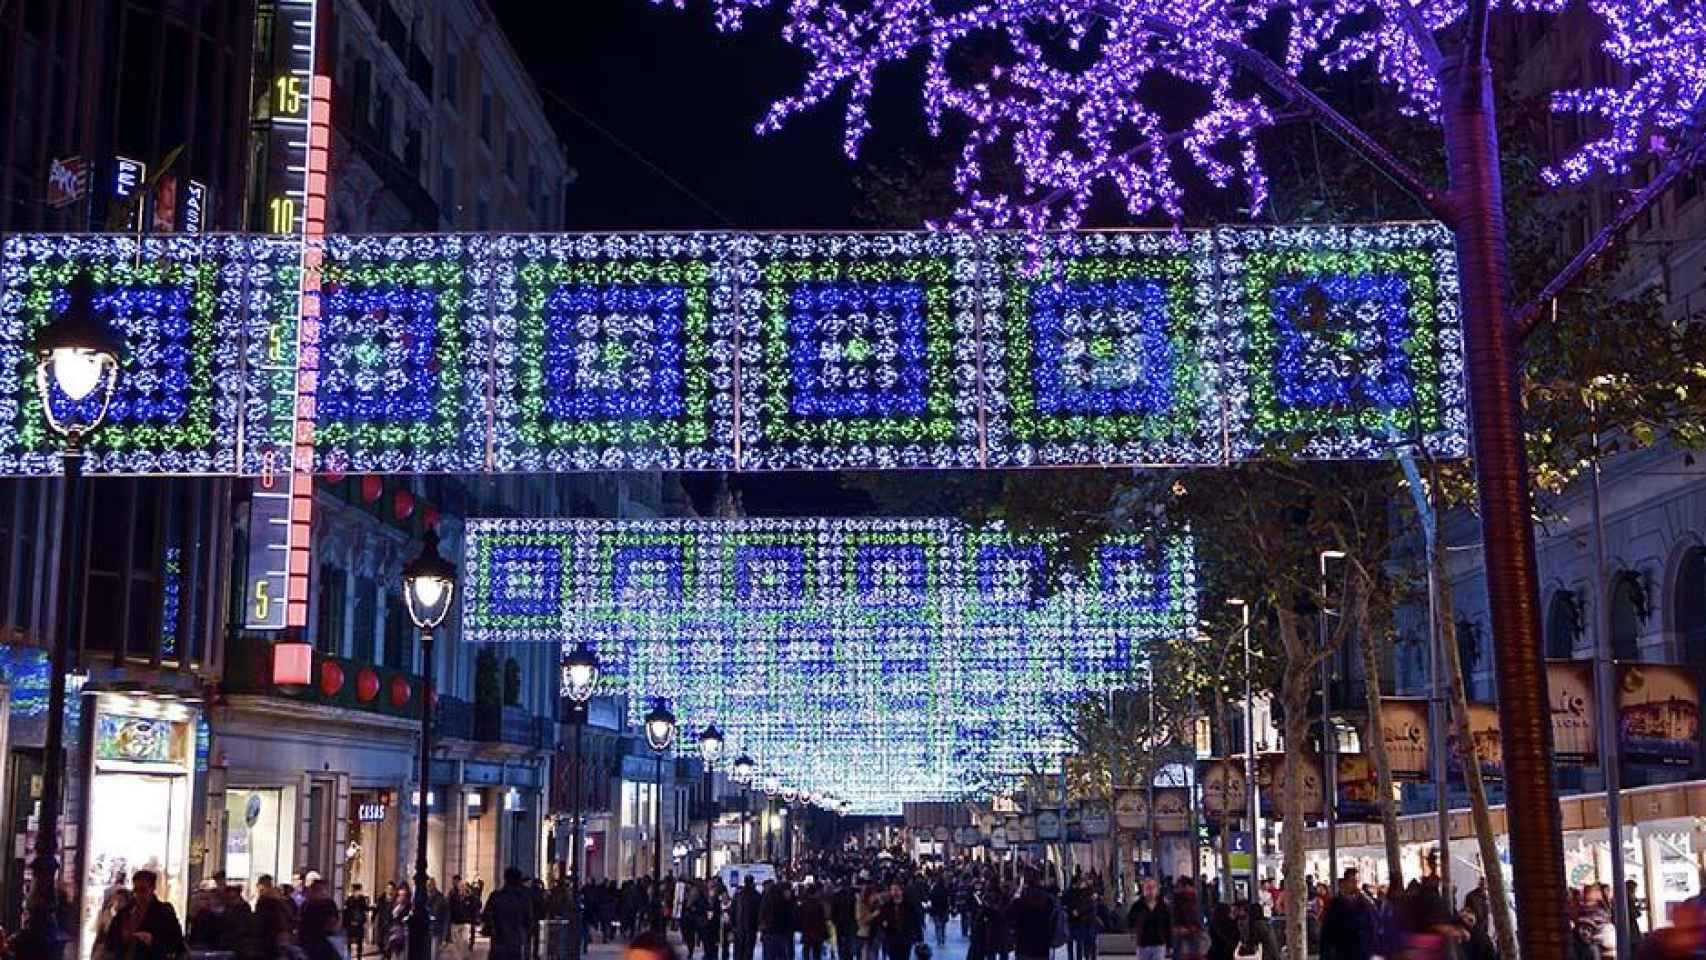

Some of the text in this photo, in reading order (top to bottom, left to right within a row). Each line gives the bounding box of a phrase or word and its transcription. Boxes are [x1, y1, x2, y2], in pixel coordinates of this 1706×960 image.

[277, 76, 300, 113] 15
[270, 198, 294, 234] 10
[255, 580, 269, 619] 5
